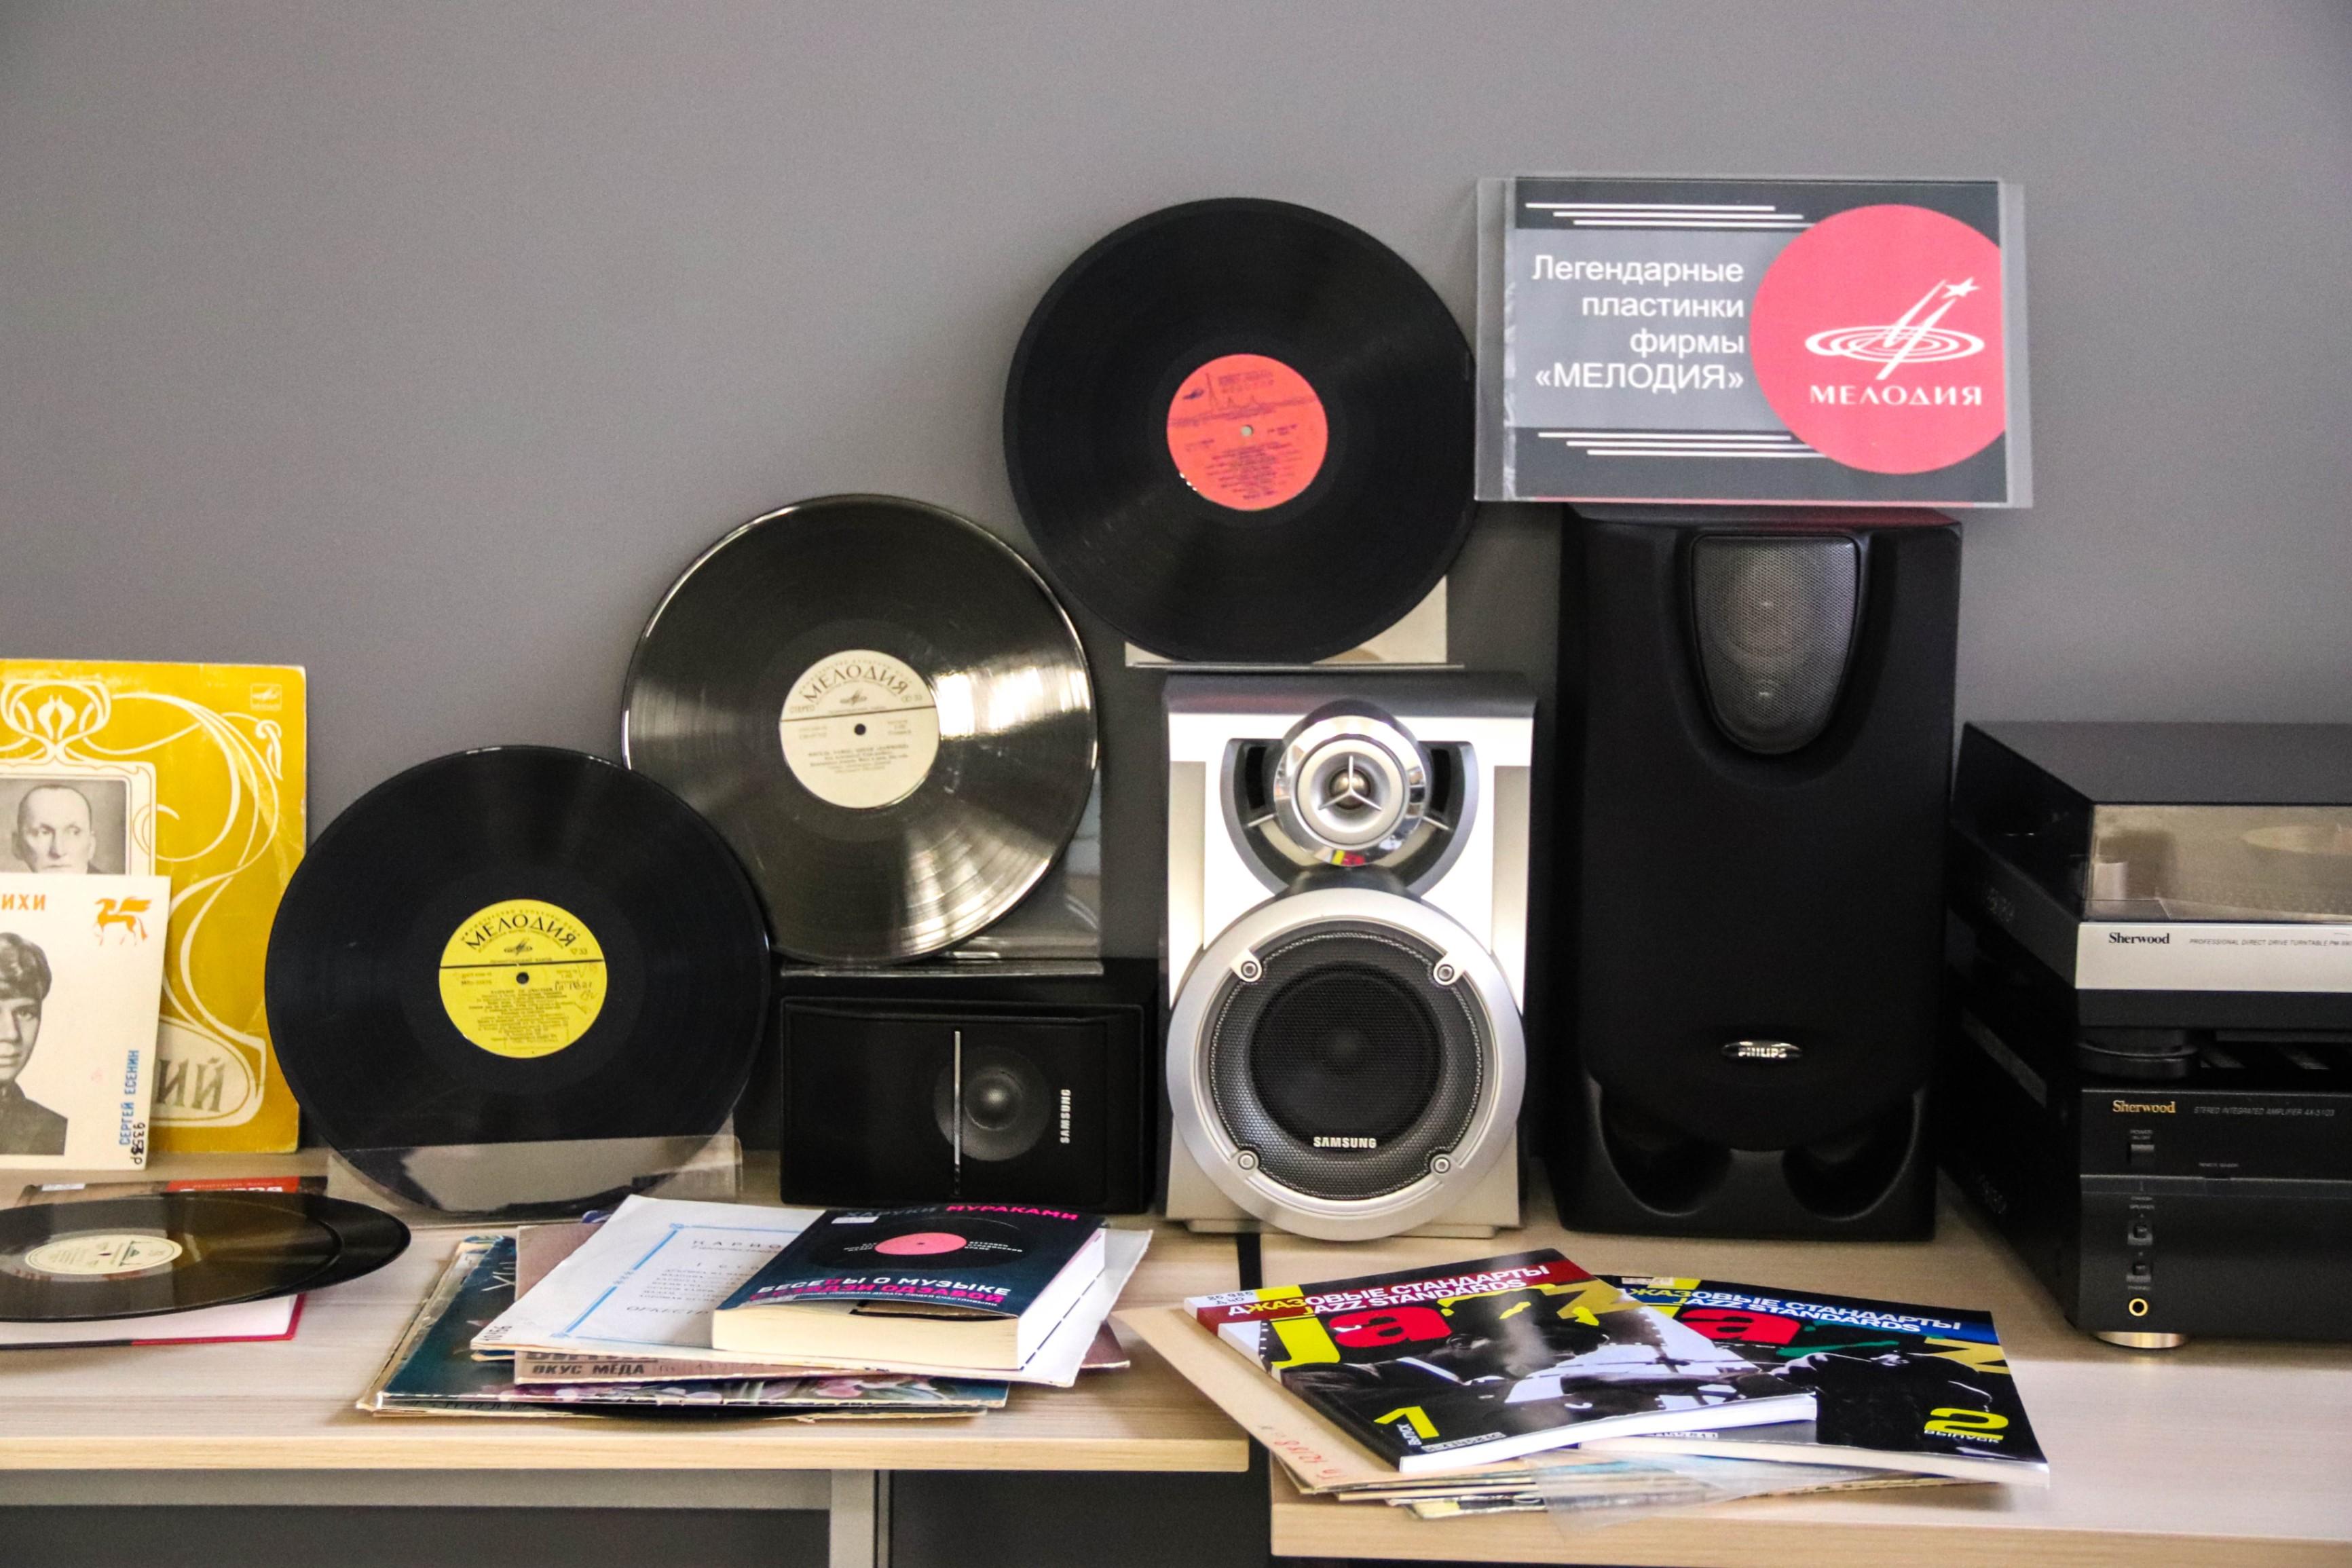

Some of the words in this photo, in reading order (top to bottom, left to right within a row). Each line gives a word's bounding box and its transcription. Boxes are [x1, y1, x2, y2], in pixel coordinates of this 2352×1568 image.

[1532, 255, 1744, 286] Легендарные
[1582, 296, 1744, 318] пластинки
[1629, 328, 1744, 359] фирмы
[1535, 362, 1744, 394] «МЕЛОДИЯ»
[1810, 385, 1983, 407] МЕЛОДИЯ
[803, 664, 909, 703] МЕЛОДИЯ
[466, 914, 576, 949] МЕЛОДИЯ
[2108, 932, 2170, 944] Sherwood
[1738, 1047, 1787, 1058] PHILIPS
[124, 1049, 139, 1094] ЕСЕНИН
[1060, 1089, 1071, 1144] SAMSUNG
[2112, 1100, 2176, 1114] Sherwood
[119, 1102, 134, 1145] СЕРГЕЙ
[1313, 1136, 1377, 1149] SAMSUNG
[945, 1205, 1079, 1220] МУРАКАМИ
[873, 1277, 891, 1285] О
[897, 1277, 1012, 1296] МУЗЫКЕ
[1228, 1288, 1389, 1316] ДЖАЗОВЫЕ
[1390, 1265, 1550, 1294] СТАНДАРТЫ
[1303, 1300, 1368, 1315] JAZZ
[1368, 1279, 1527, 1307] STANDARDS
[1629, 1287, 1780, 1306] ЖАЗОВЫЕ
[1785, 1301, 1961, 1330] СТАНДАРТЫ
[1673, 1296, 1742, 1309] JAZZ
[1747, 1303, 1921, 1332] STANDARDS
[532, 1364, 582, 1375] ВКУС
[1924, 1408, 2009, 1441] 2
